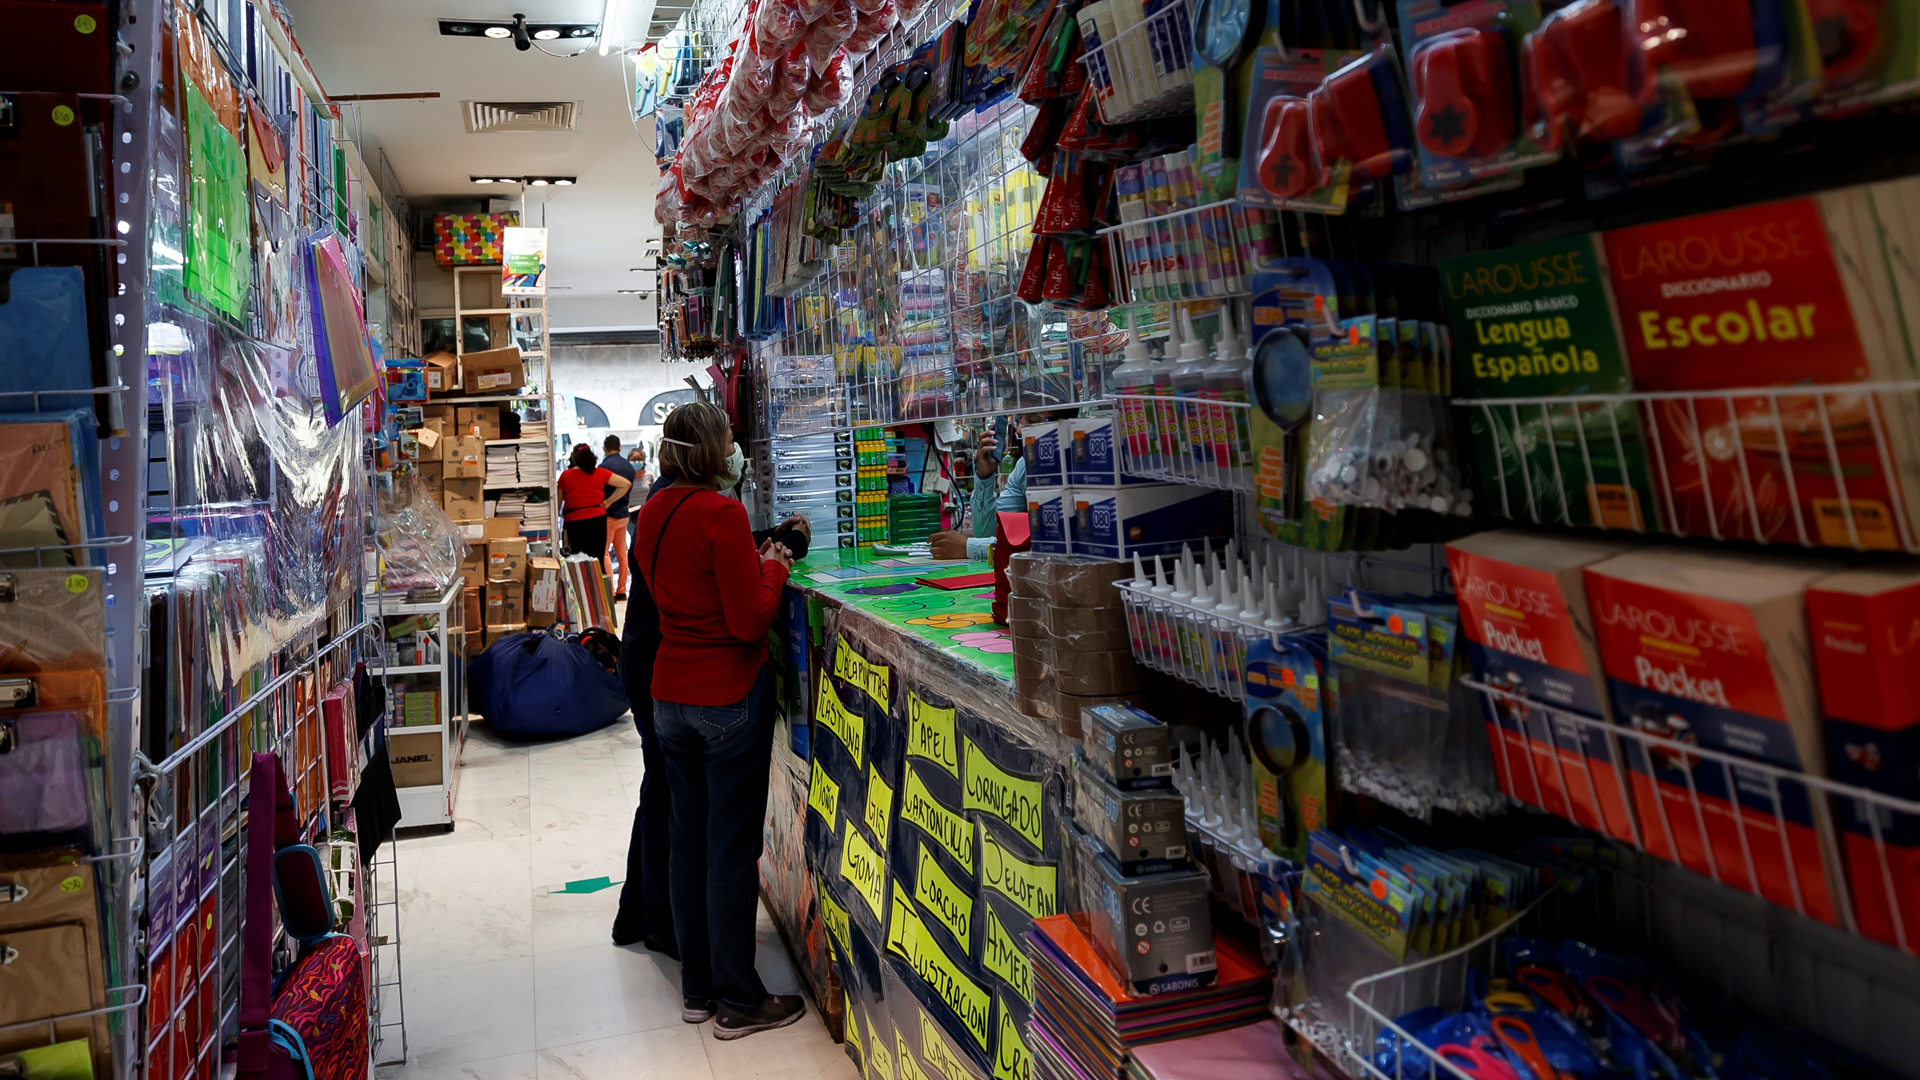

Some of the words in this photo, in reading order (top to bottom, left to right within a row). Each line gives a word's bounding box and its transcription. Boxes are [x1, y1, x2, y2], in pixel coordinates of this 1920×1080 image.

[1616, 218, 1813, 282] LAROUSSE
[1446, 250, 1589, 300] LAROUSSE
[1661, 269, 1773, 299] DICCIONARIO
[1464, 300, 1533, 319] DICCIONARIO
[1534, 294, 1579, 311] BÁSICO
[1637, 297, 1817, 351] Escolar
[1475, 314, 1571, 348] Lengua
[1471, 344, 1600, 383] Española
[1038, 441, 1055, 460] 080
[1089, 437, 1107, 457] 080
[1043, 508, 1059, 527] 080
[1092, 509, 1111, 529] 080
[1453, 573, 1557, 619] LAROUSSE
[1482, 620, 1547, 664] Pocket
[1596, 598, 1750, 657] LAROUSSE
[1633, 653, 1731, 709] Pocket
[910, 697, 956, 767] PAPEL
[1122, 733, 1135, 745] CE
[391, 754, 432, 765] JANEL
[868, 774, 887, 842] GIS
[966, 743, 1041, 840] CORRUGADO
[1105, 795, 1120, 823] 317
[1128, 803, 1142, 819] CE
[904, 770, 973, 865] CARTONCILLO
[847, 831, 882, 905] GOMA
[1144, 864, 1173, 874] SABONIS
[920, 853, 967, 937] CORCHO
[1132, 896, 1152, 916] CE
[892, 896, 987, 1038] ILUSTRACION
[1160, 978, 1200, 992] SABONIS
[1000, 1012, 1029, 1080] CRA
